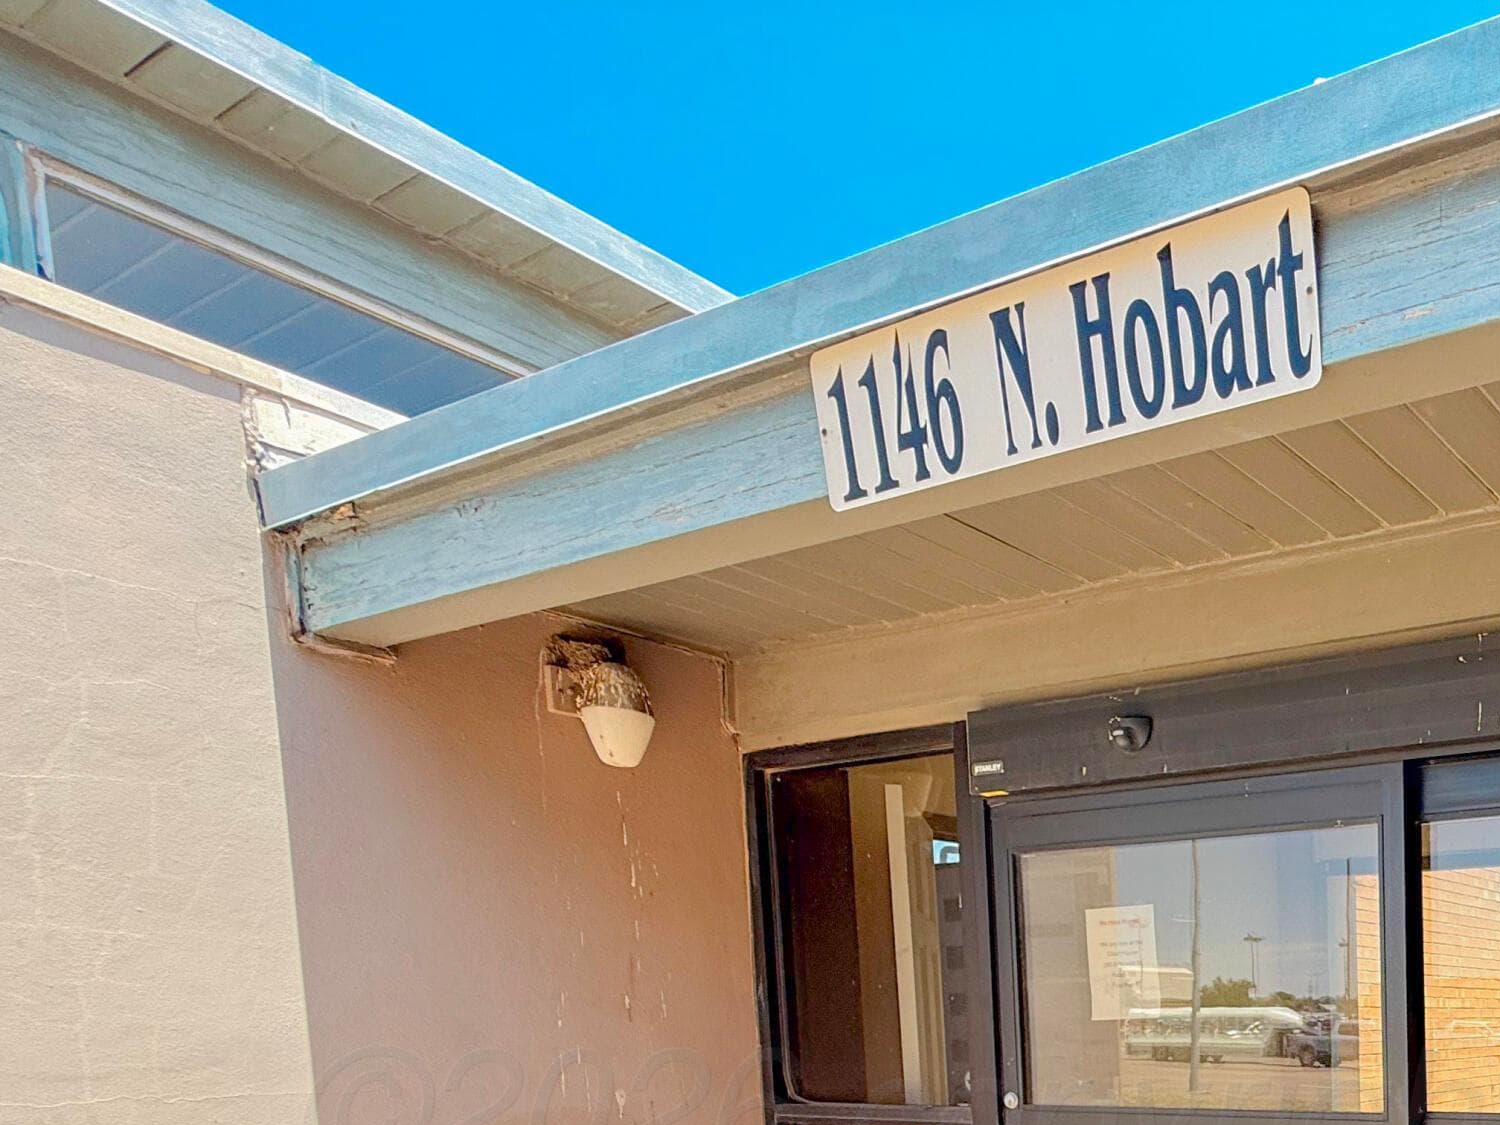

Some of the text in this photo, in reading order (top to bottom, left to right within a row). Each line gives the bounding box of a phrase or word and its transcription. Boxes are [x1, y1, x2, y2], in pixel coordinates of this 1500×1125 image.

[827, 208, 1313, 503] 1146 N. Hobart
